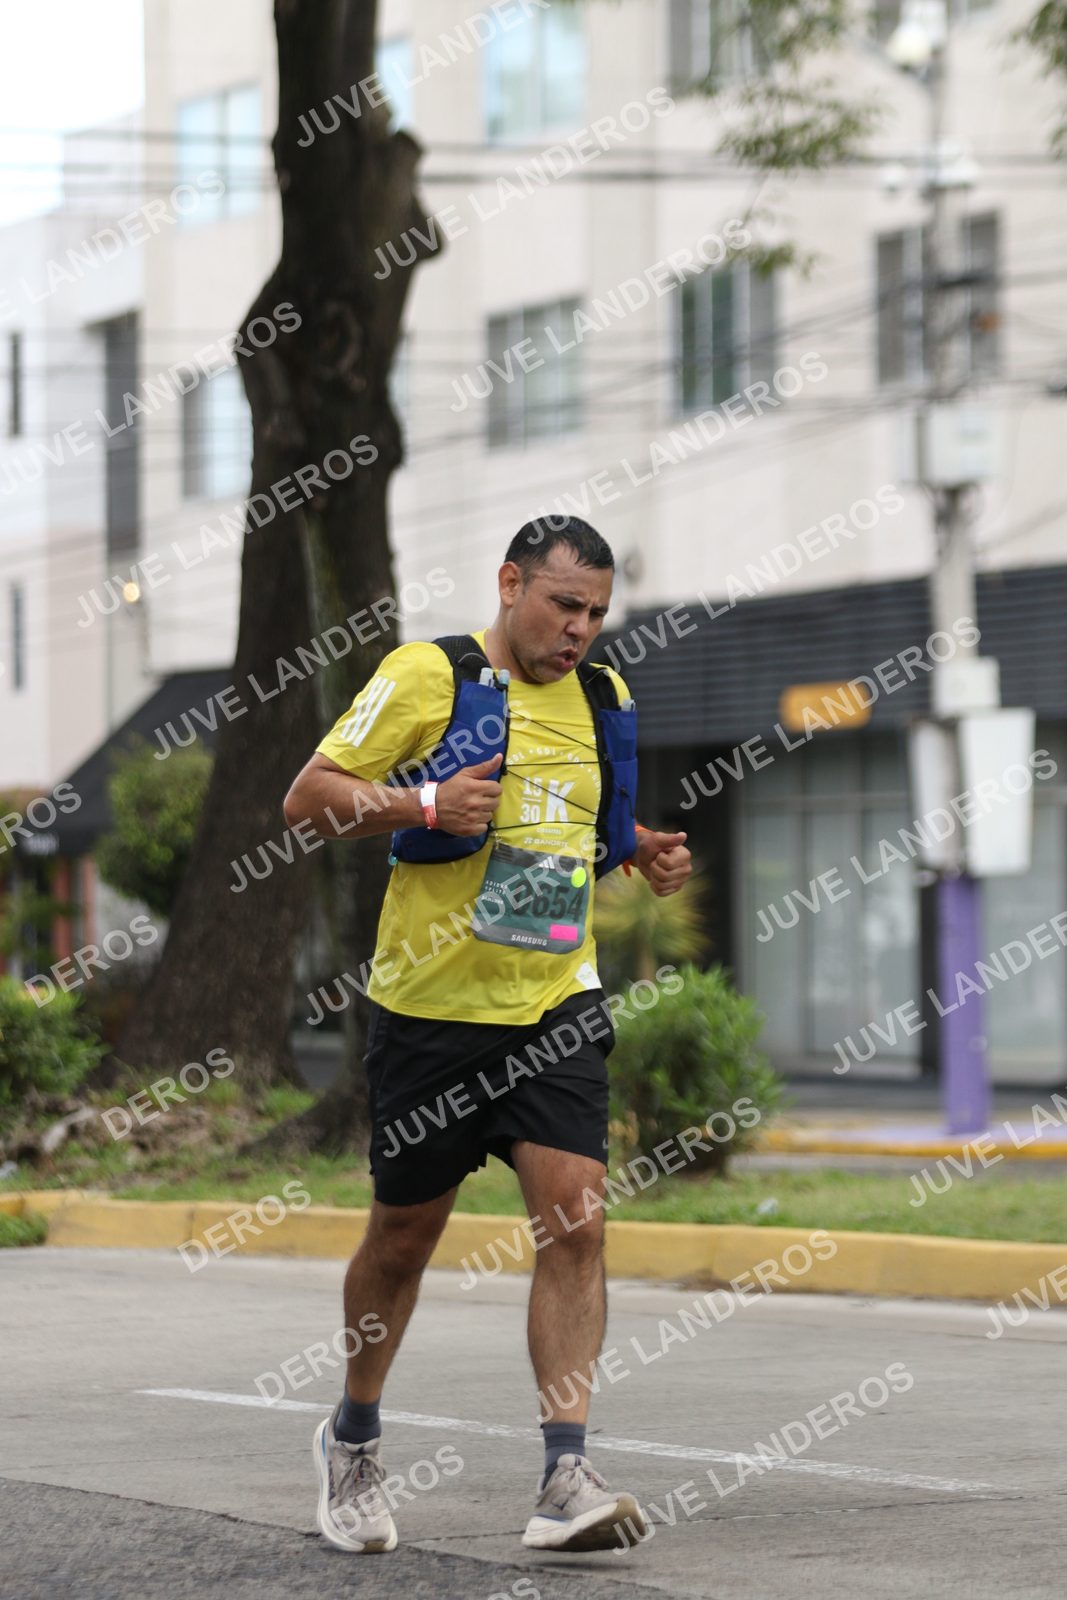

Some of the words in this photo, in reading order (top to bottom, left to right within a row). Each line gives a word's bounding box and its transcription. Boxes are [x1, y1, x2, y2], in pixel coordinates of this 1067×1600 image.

[522, 776, 543, 796] 15
[545, 779, 576, 822] K
[520, 803, 540, 823] 30
[510, 934, 548, 946] SAMSUNG
